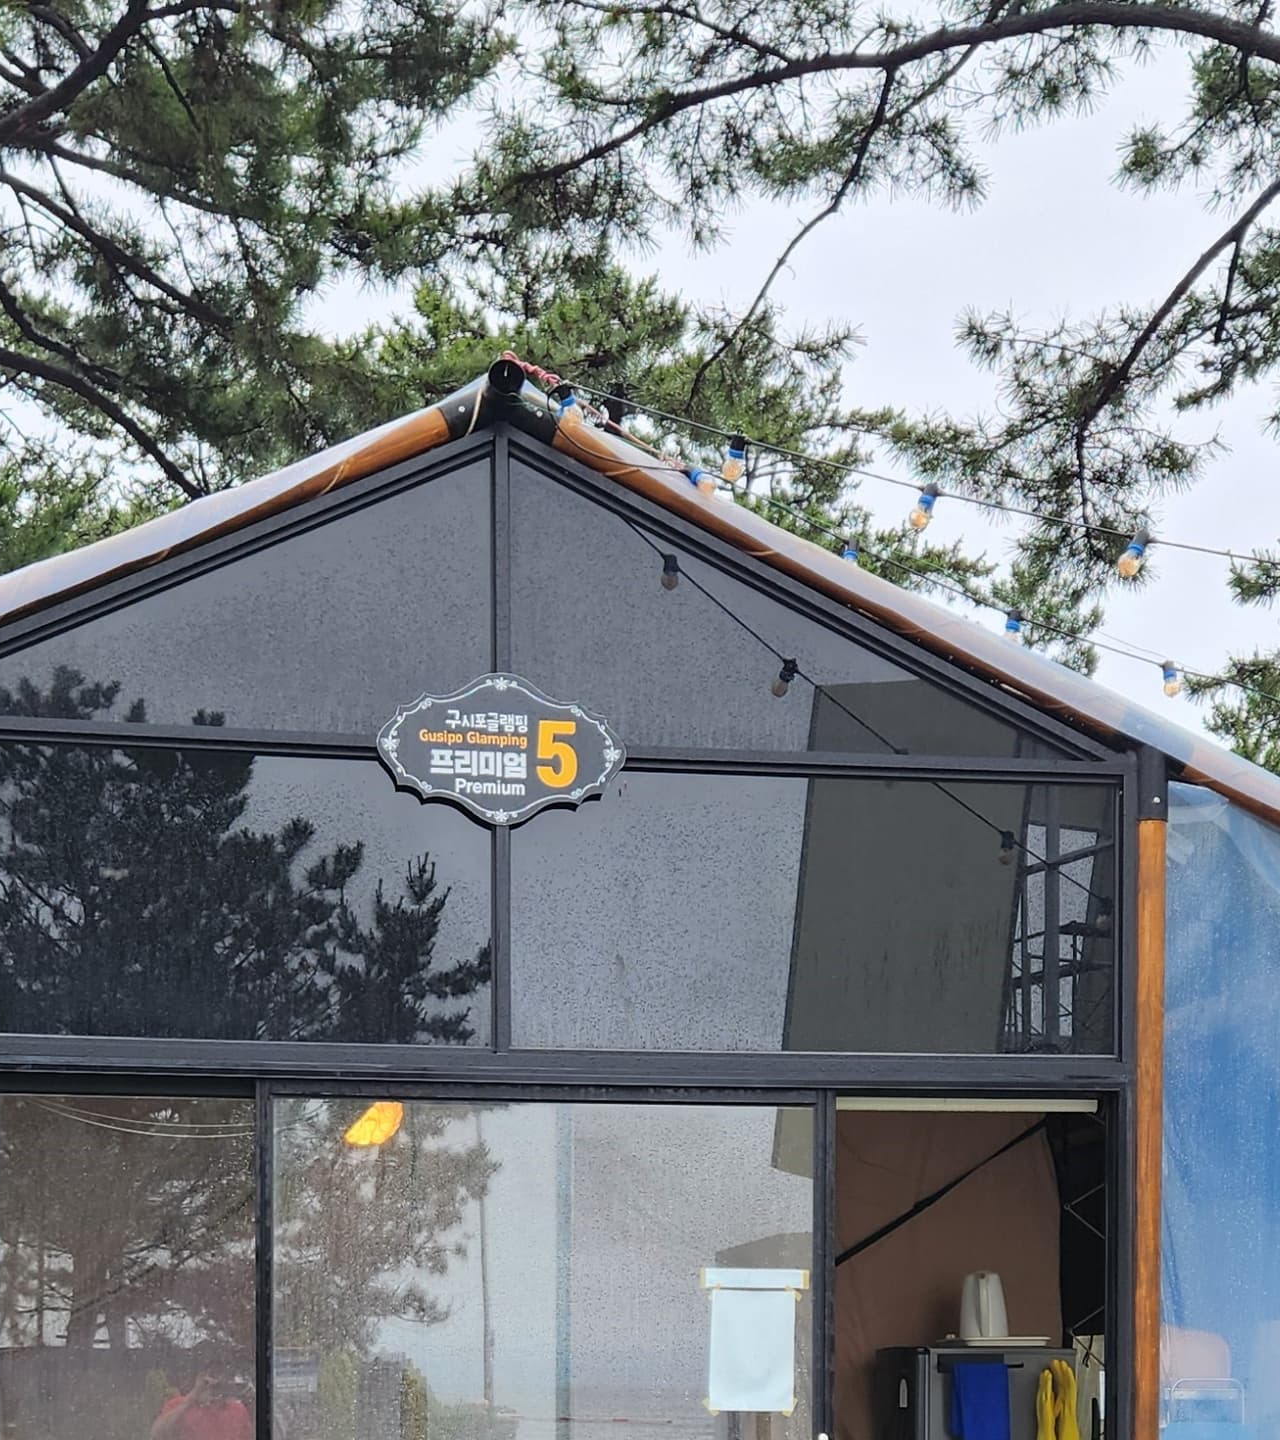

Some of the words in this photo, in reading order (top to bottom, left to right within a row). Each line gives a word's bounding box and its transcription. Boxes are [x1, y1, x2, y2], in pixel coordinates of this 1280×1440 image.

[445, 710, 528, 732] 구시포글램핑
[419, 729, 464, 745] Gusipo
[466, 731, 527, 748] Glamping
[430, 749, 527, 778] 프리미엄
[536, 720, 578, 788] 5
[455, 778, 526, 796] Premium
